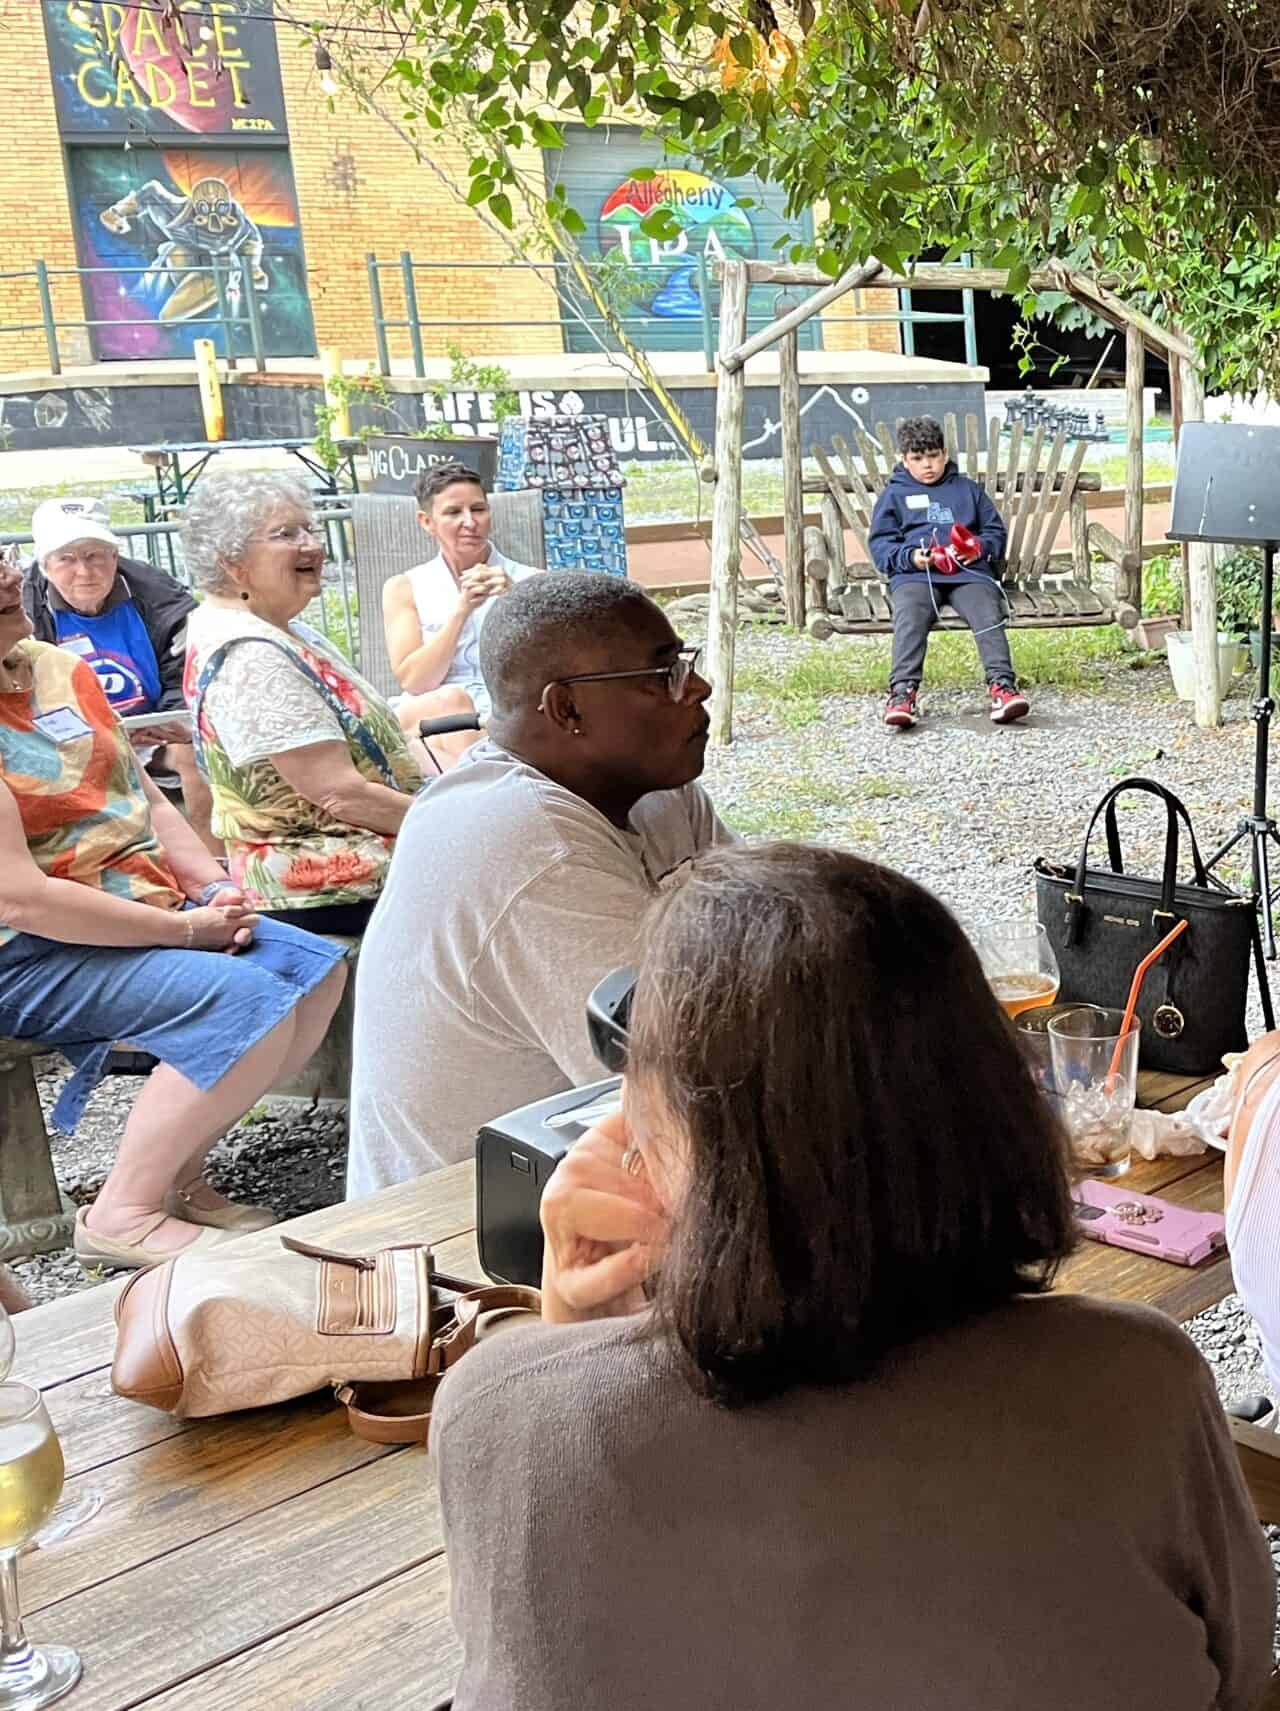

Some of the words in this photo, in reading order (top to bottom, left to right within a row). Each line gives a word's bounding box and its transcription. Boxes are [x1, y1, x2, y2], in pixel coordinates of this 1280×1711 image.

[66, 0, 242, 57] SPACE
[76, 59, 251, 109] CADET
[624, 178, 724, 210] Allegheny
[421, 391, 497, 422] LIFE
[518, 390, 557, 418] IS
